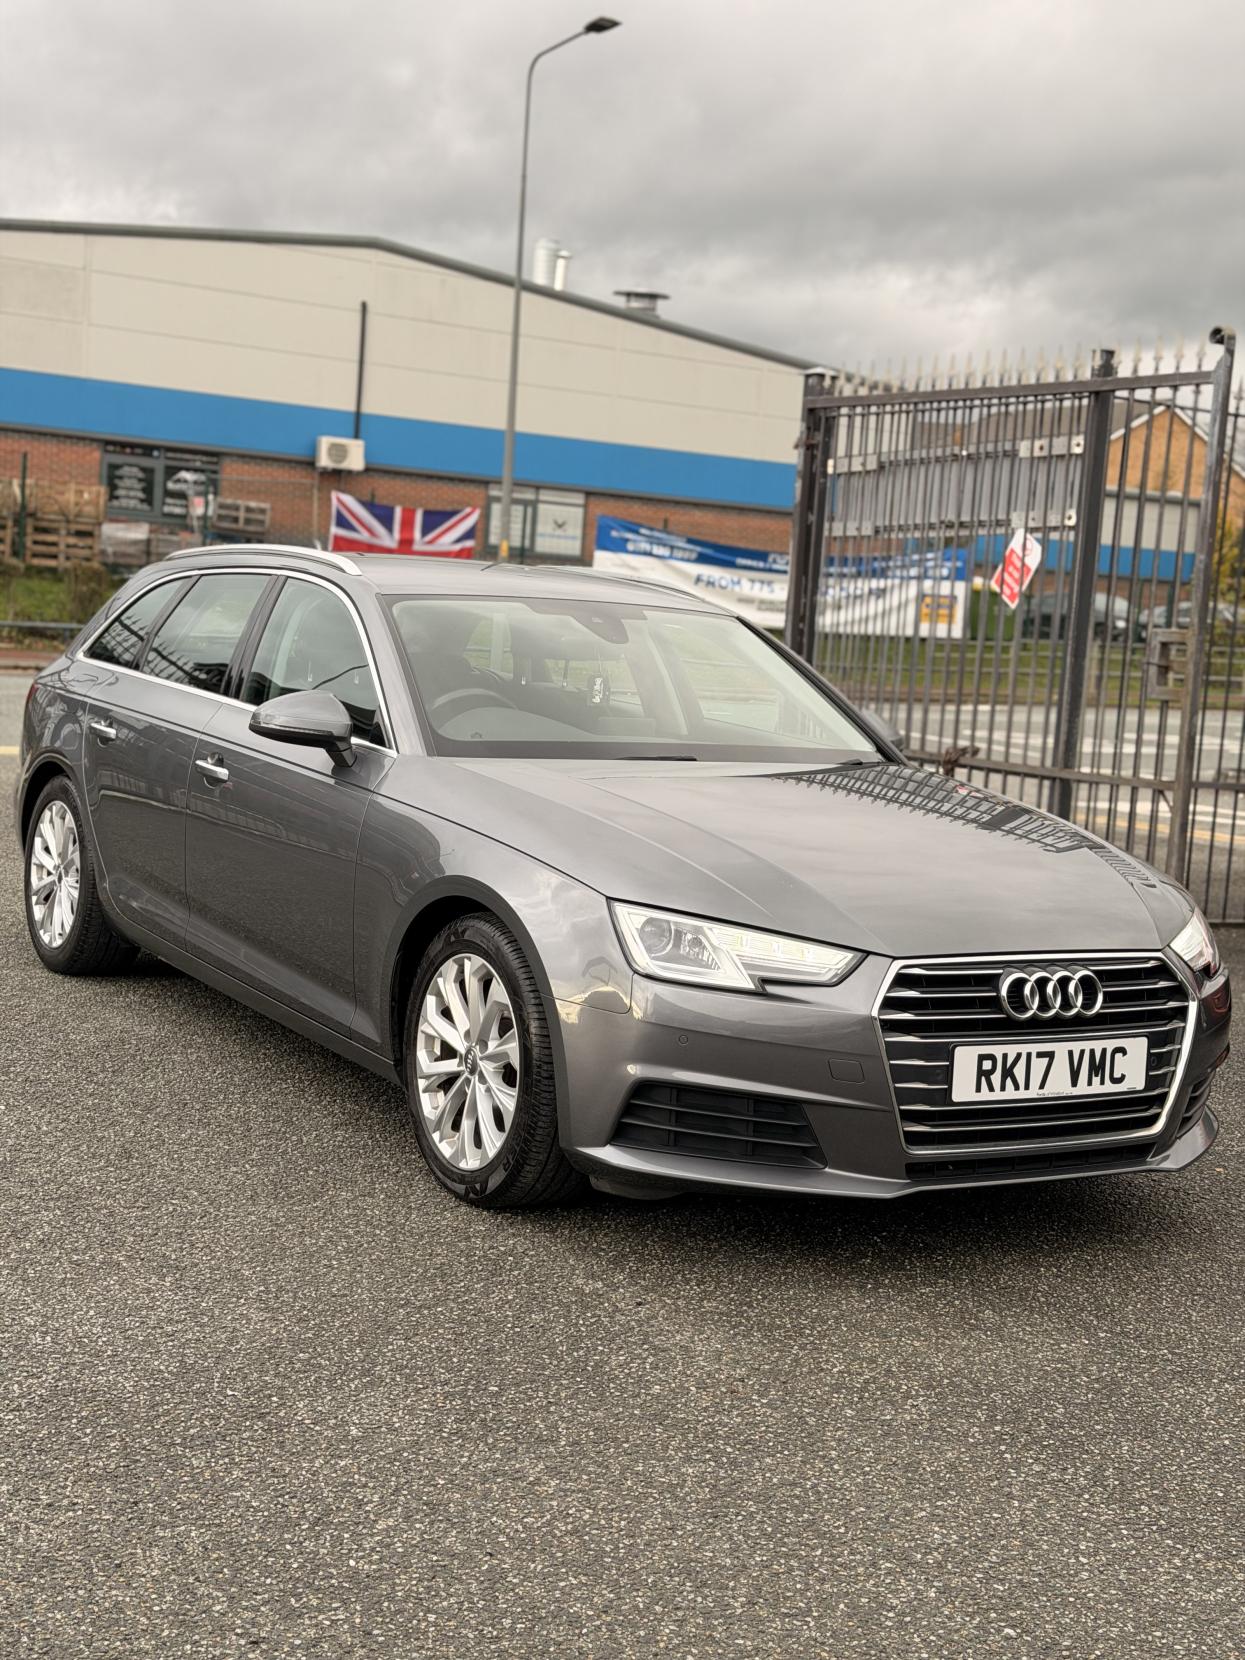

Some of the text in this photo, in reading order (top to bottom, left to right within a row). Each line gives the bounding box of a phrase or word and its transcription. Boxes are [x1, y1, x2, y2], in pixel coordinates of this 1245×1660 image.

[694, 573, 742, 592] FROM
[975, 1046, 1128, 1093] RK17 VMC
